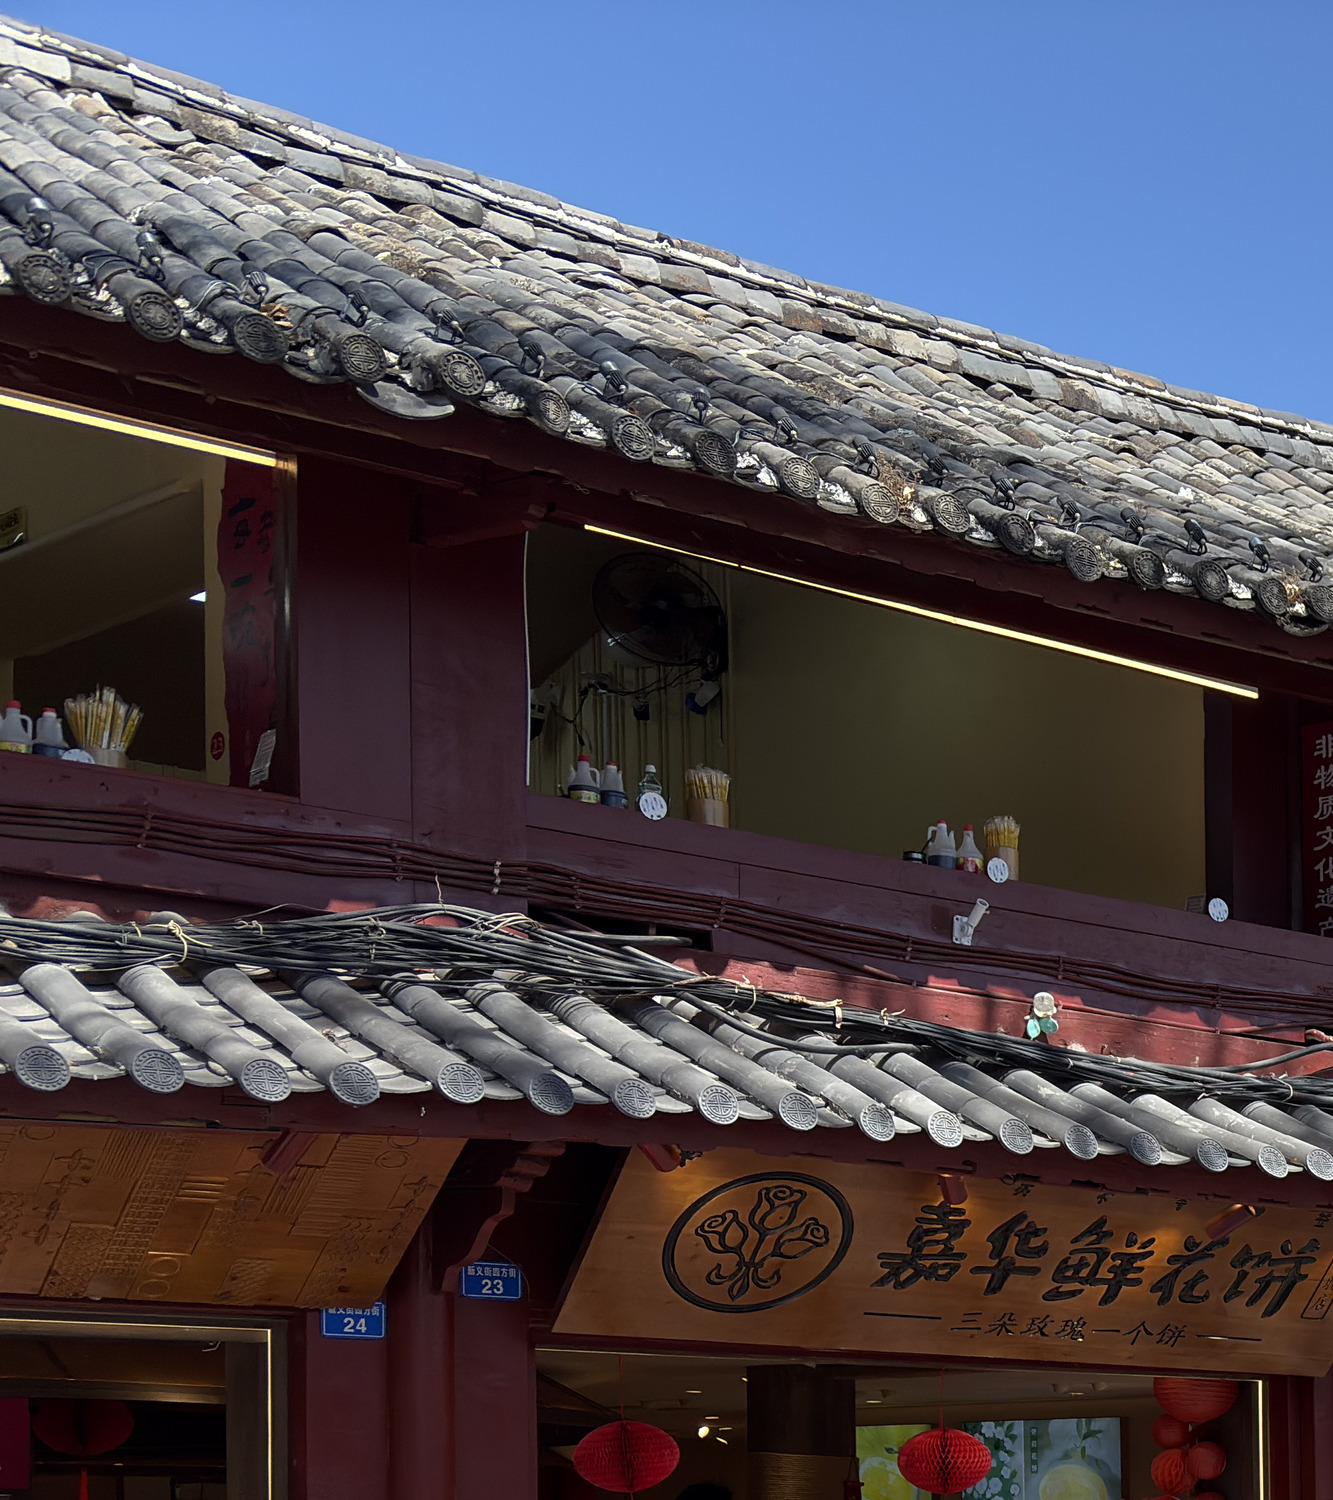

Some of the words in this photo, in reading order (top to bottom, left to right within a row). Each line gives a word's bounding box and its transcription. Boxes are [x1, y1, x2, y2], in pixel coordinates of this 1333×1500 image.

[869, 1201, 1322, 1319] 嘉华鲜花饼
[482, 1279, 504, 1294] 23
[343, 1318, 367, 1333] 24
[950, 1312, 1188, 1348] 三朵玫瑰一个饼
